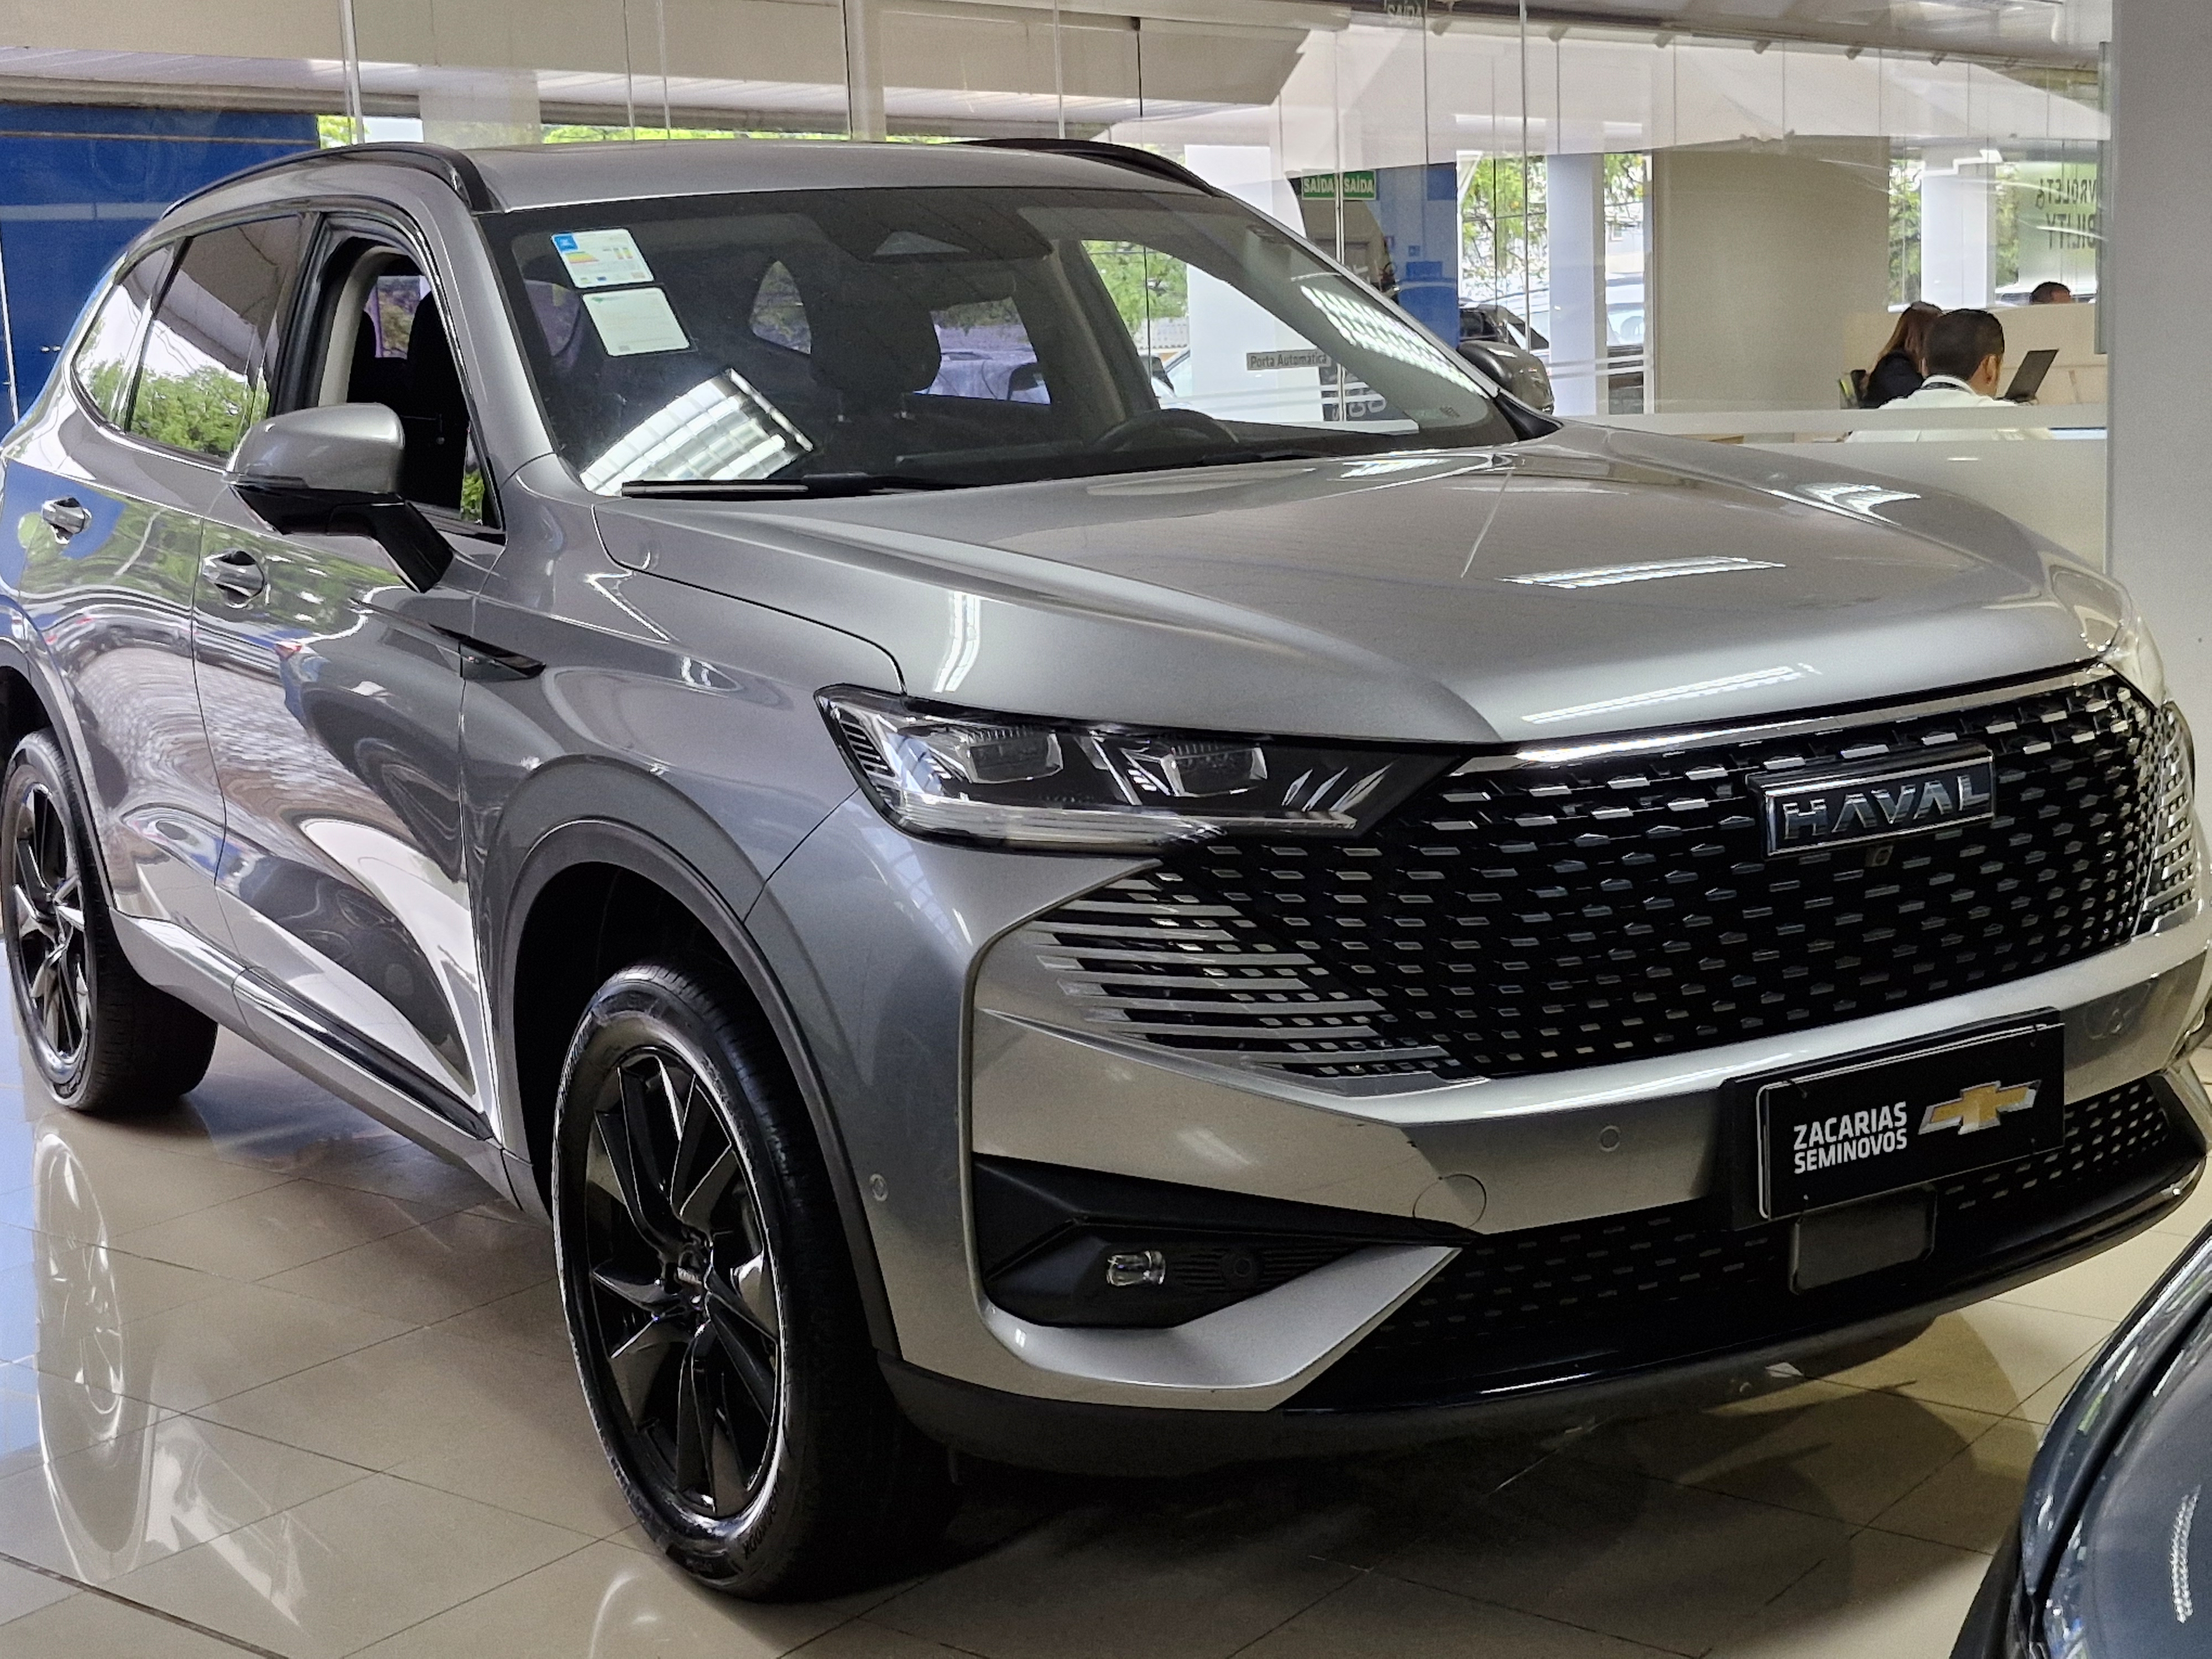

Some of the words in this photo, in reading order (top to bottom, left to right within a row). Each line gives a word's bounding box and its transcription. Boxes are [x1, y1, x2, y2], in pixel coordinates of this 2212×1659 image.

[1304, 175, 1334, 192] SAÍDA
[1344, 175, 1374, 193] SAÍDA
[1250, 355, 1275, 368] Porta
[1277, 352, 1327, 367] Automática
[1781, 774, 1990, 840] HAVAL
[1793, 1101, 1907, 1151] ZACARIAS
[1794, 1128, 1907, 1175] SEMINOVOS
